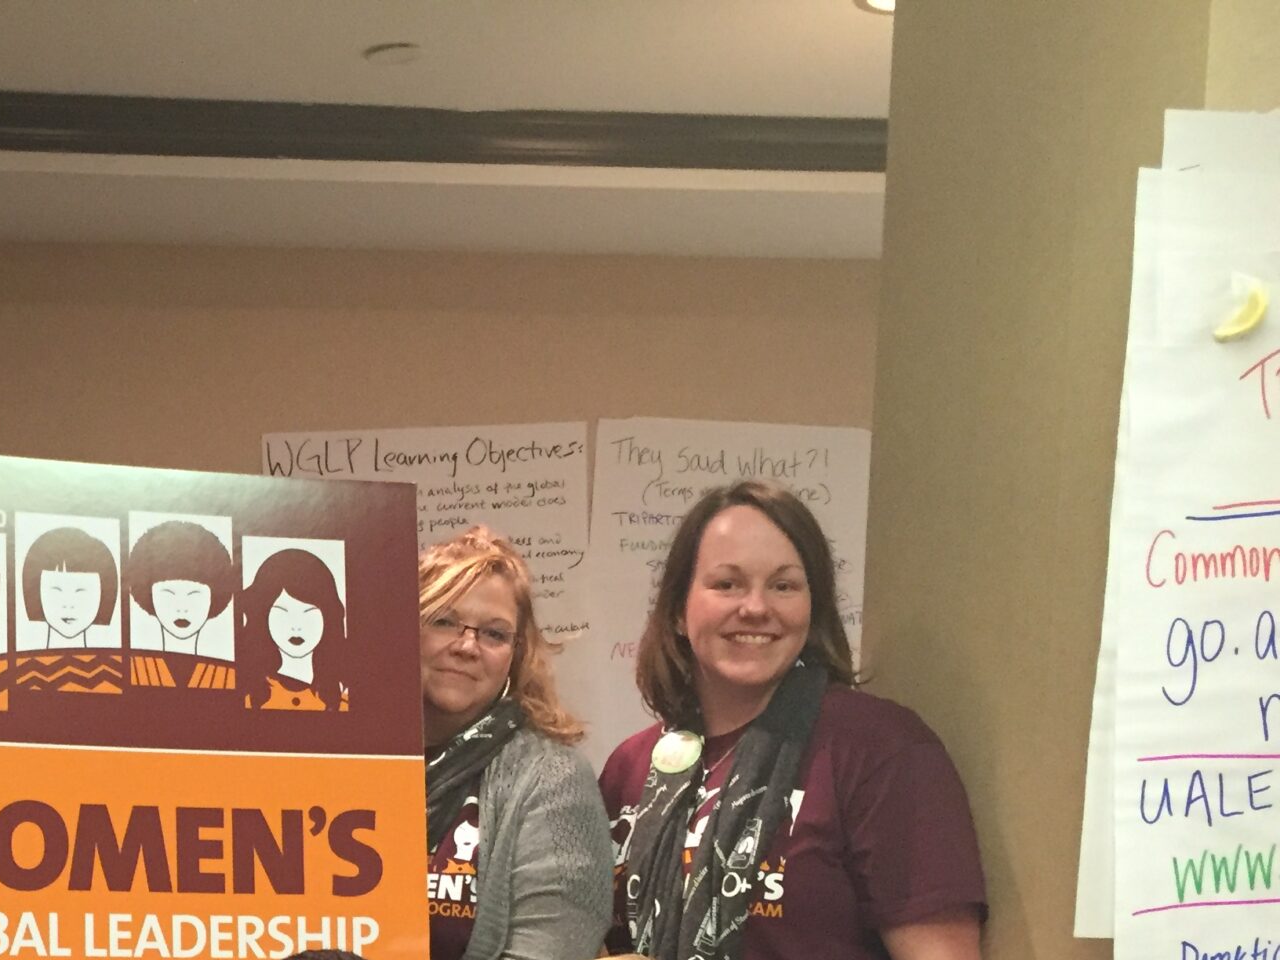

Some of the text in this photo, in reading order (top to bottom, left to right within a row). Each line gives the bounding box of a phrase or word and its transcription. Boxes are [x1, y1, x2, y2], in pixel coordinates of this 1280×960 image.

[266, 437, 363, 477] WGLP
[373, 437, 459, 478] Learning
[609, 435, 664, 482] They
[675, 447, 728, 475] Said
[427, 481, 481, 501] analysis
[486, 481, 499, 495] of
[526, 479, 566, 498] global
[436, 501, 486, 512] current
[429, 515, 470, 532] people
[1139, 768, 1275, 827] UALE
[83, 911, 381, 958] LEADERSHIP
